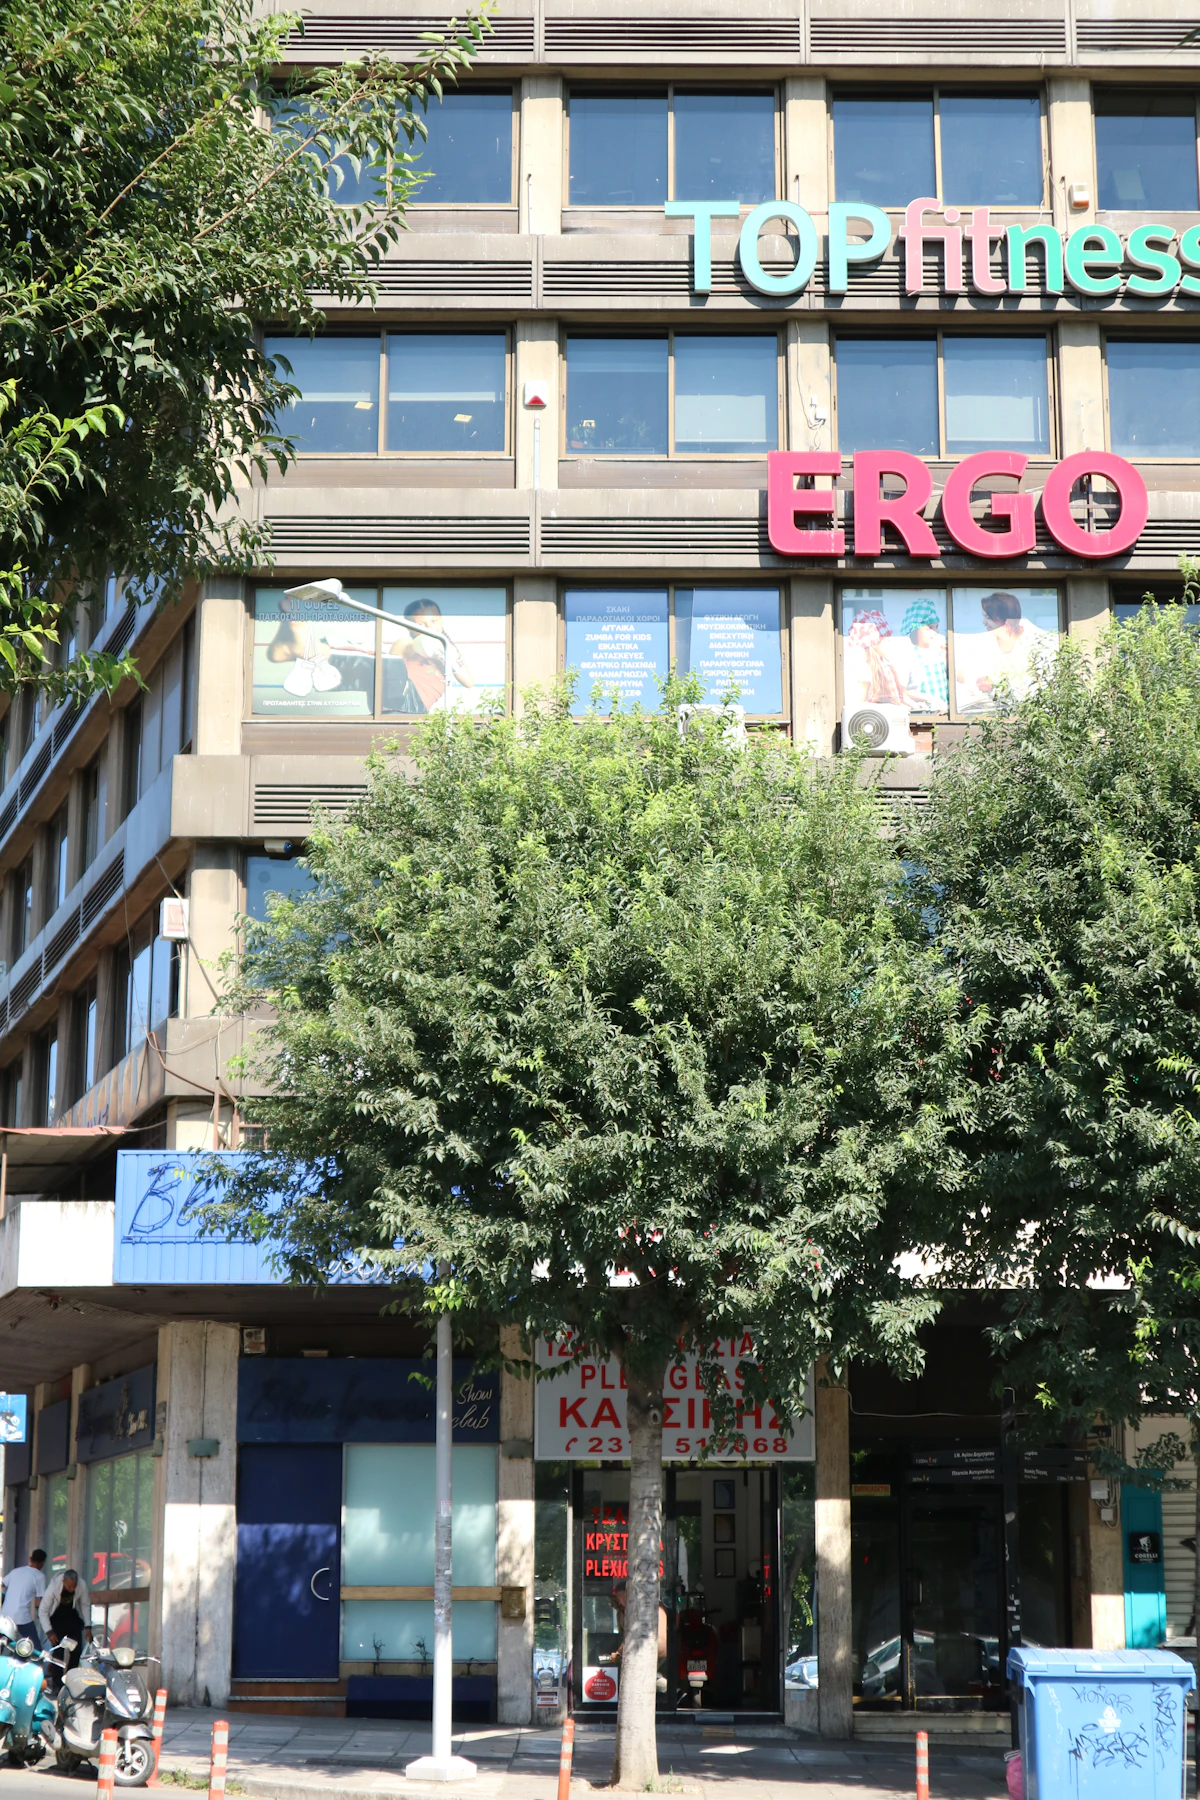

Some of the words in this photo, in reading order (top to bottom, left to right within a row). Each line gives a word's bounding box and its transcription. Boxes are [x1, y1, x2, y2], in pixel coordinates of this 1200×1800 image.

[767, 450, 1149, 559] ERGO
[259, 612, 308, 622] ΠΑΓΚΟΣΜΙΟΙ
[313, 612, 369, 622] ΠΡΩΤΑΘΛΗΤΕΣ
[625, 689, 642, 697] ΣΕΦ
[456, 1382, 493, 1405] Show
[451, 1404, 491, 1429] club
